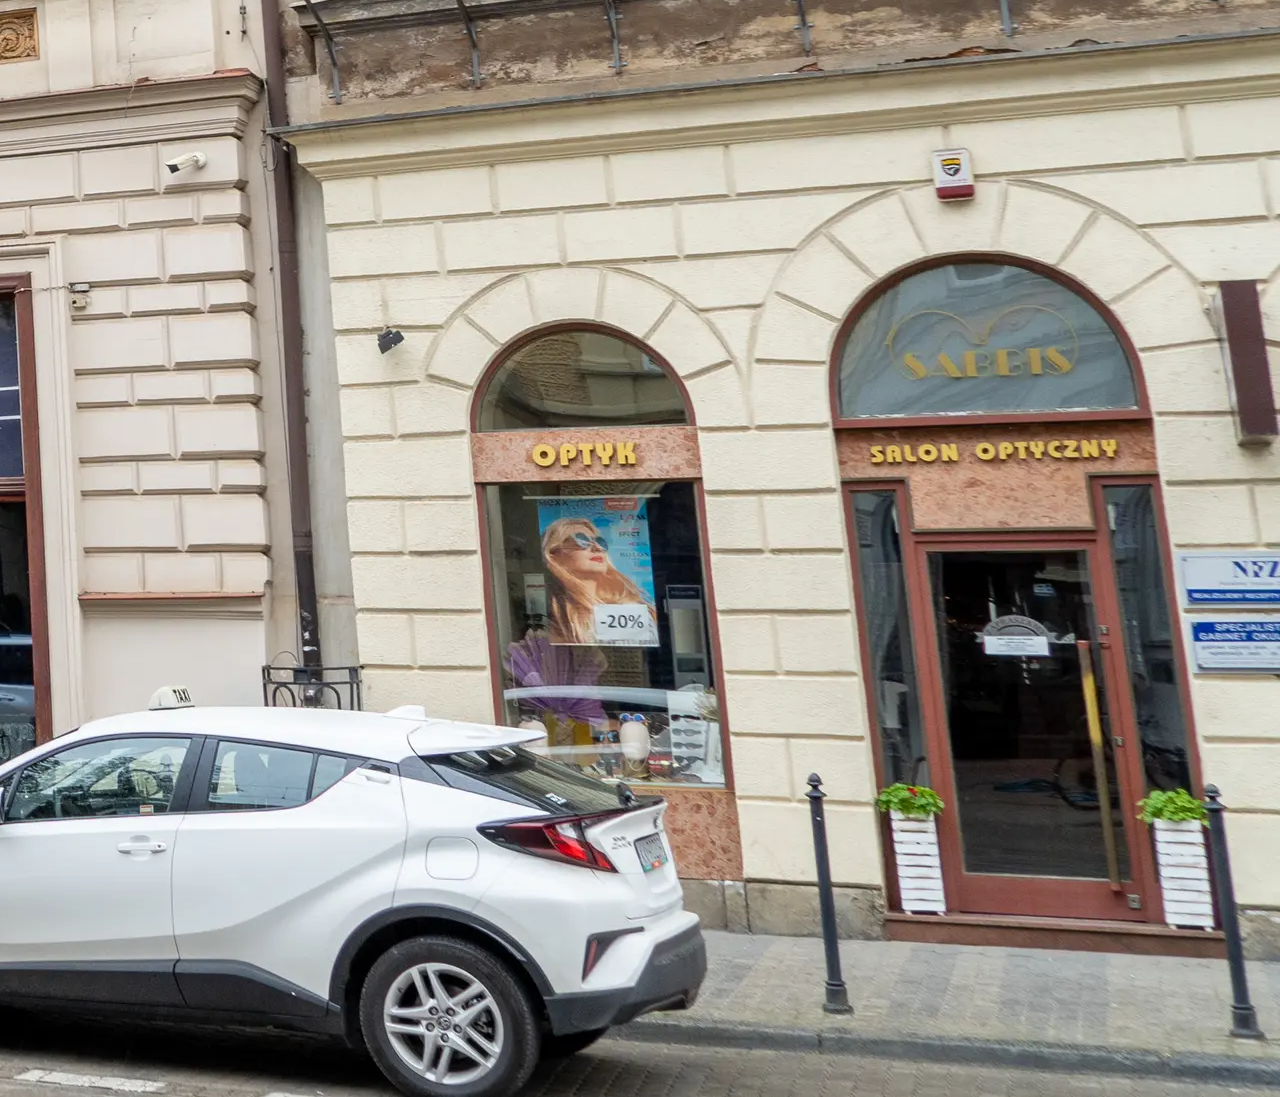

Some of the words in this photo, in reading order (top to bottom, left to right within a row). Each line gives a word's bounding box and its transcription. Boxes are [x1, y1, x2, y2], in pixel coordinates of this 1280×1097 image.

[531, 441, 638, 468] OPTYK
[870, 442, 960, 464] SALON
[975, 438, 1118, 461] OPTYCZNY
[1231, 560, 1280, 579] NFZ
[599, 613, 645, 630] -20%
[1198, 632, 1248, 641] GABINET
[171, 688, 192, 704] TAXI
